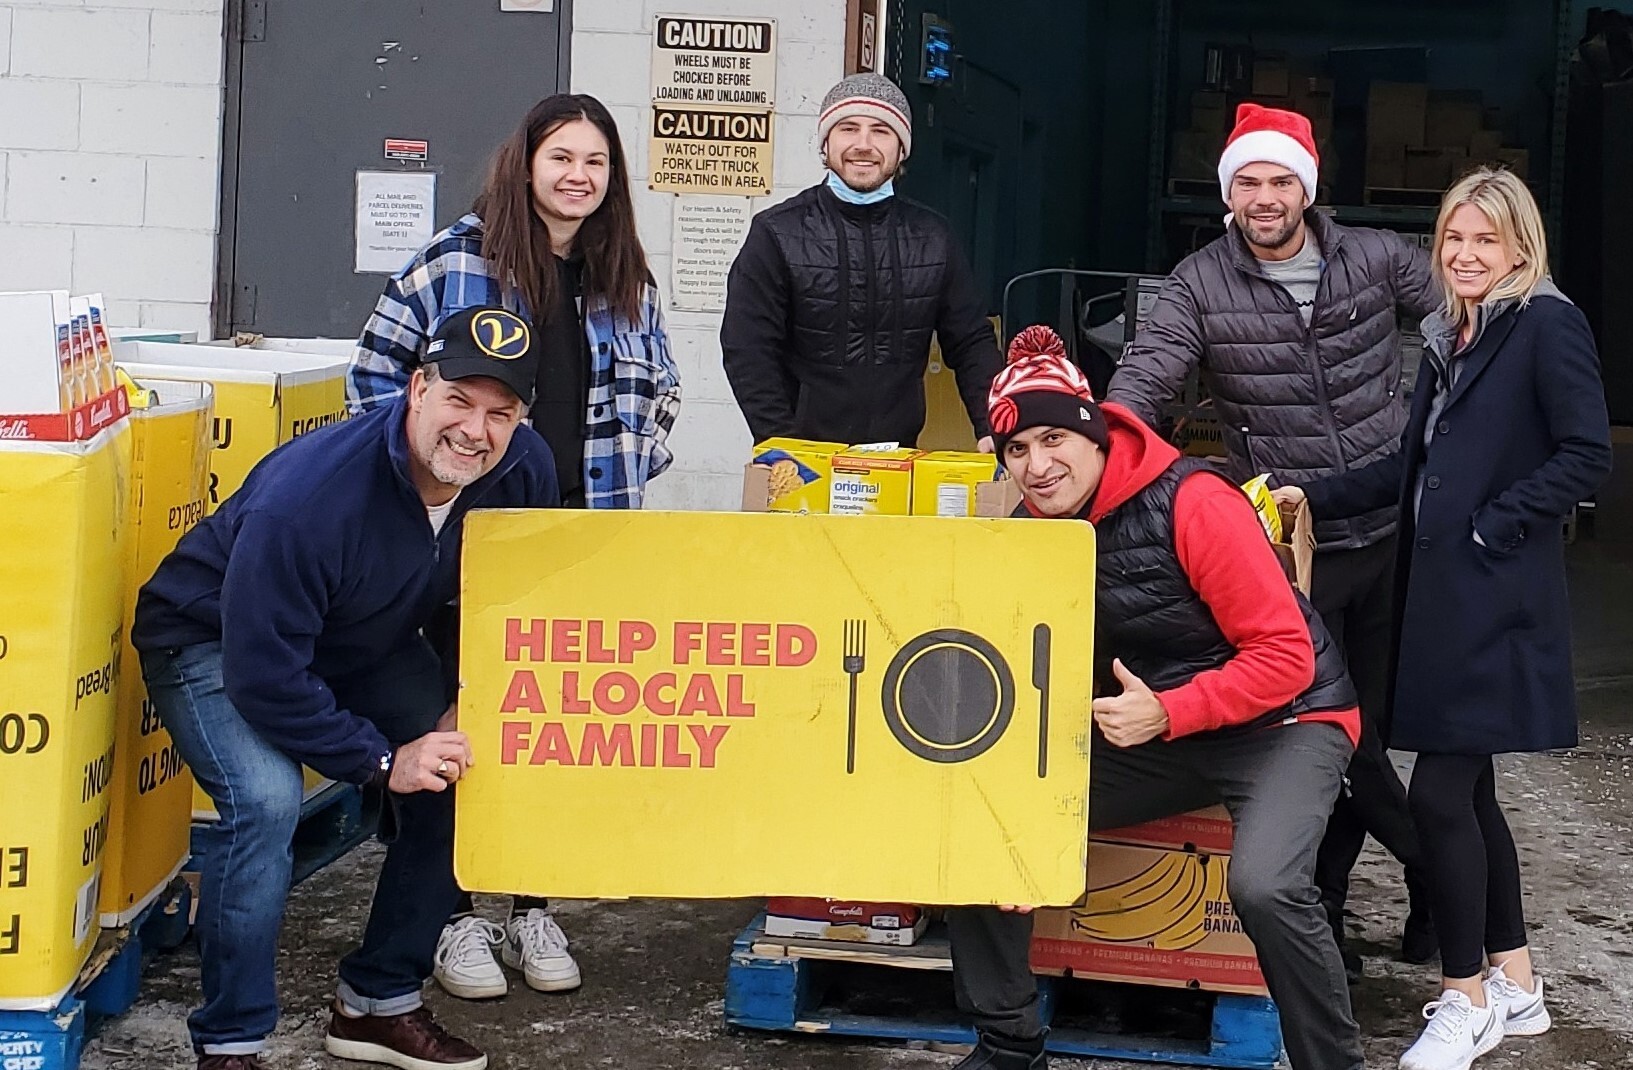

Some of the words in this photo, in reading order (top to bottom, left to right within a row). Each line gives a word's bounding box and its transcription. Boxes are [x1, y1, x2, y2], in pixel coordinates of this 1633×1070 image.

[665, 20, 763, 50] CAUTION
[674, 54, 710, 68] WHEELS
[712, 56, 737, 69] MUST
[739, 57, 751, 70] BE
[673, 70, 714, 84] CHOCKED
[717, 72, 751, 86] BEFORE
[656, 86, 694, 100] LOADING
[696, 88, 714, 101] AND
[717, 89, 767, 103] UNLOADING
[657, 112, 767, 139] CAUTION
[664, 143, 705, 156] WATCH
[708, 144, 731, 157] OUT
[734, 145, 757, 159] FOR
[662, 157, 693, 170] FORK
[695, 159, 719, 171] LIFT
[721, 160, 759, 173] TRUCK
[654, 171, 719, 186] OPERATING
[721, 174, 732, 187] IN
[735, 175, 766, 188] AREA
[834, 480, 880, 495] original
[504, 617, 657, 664] HELP
[672, 621, 818, 667] FEED
[499, 670, 547, 714] A
[561, 670, 756, 718] LOCAL
[501, 721, 731, 769] FAMILY
[139, 752, 157, 796] TO
[1203, 918, 1245, 934] BANA
